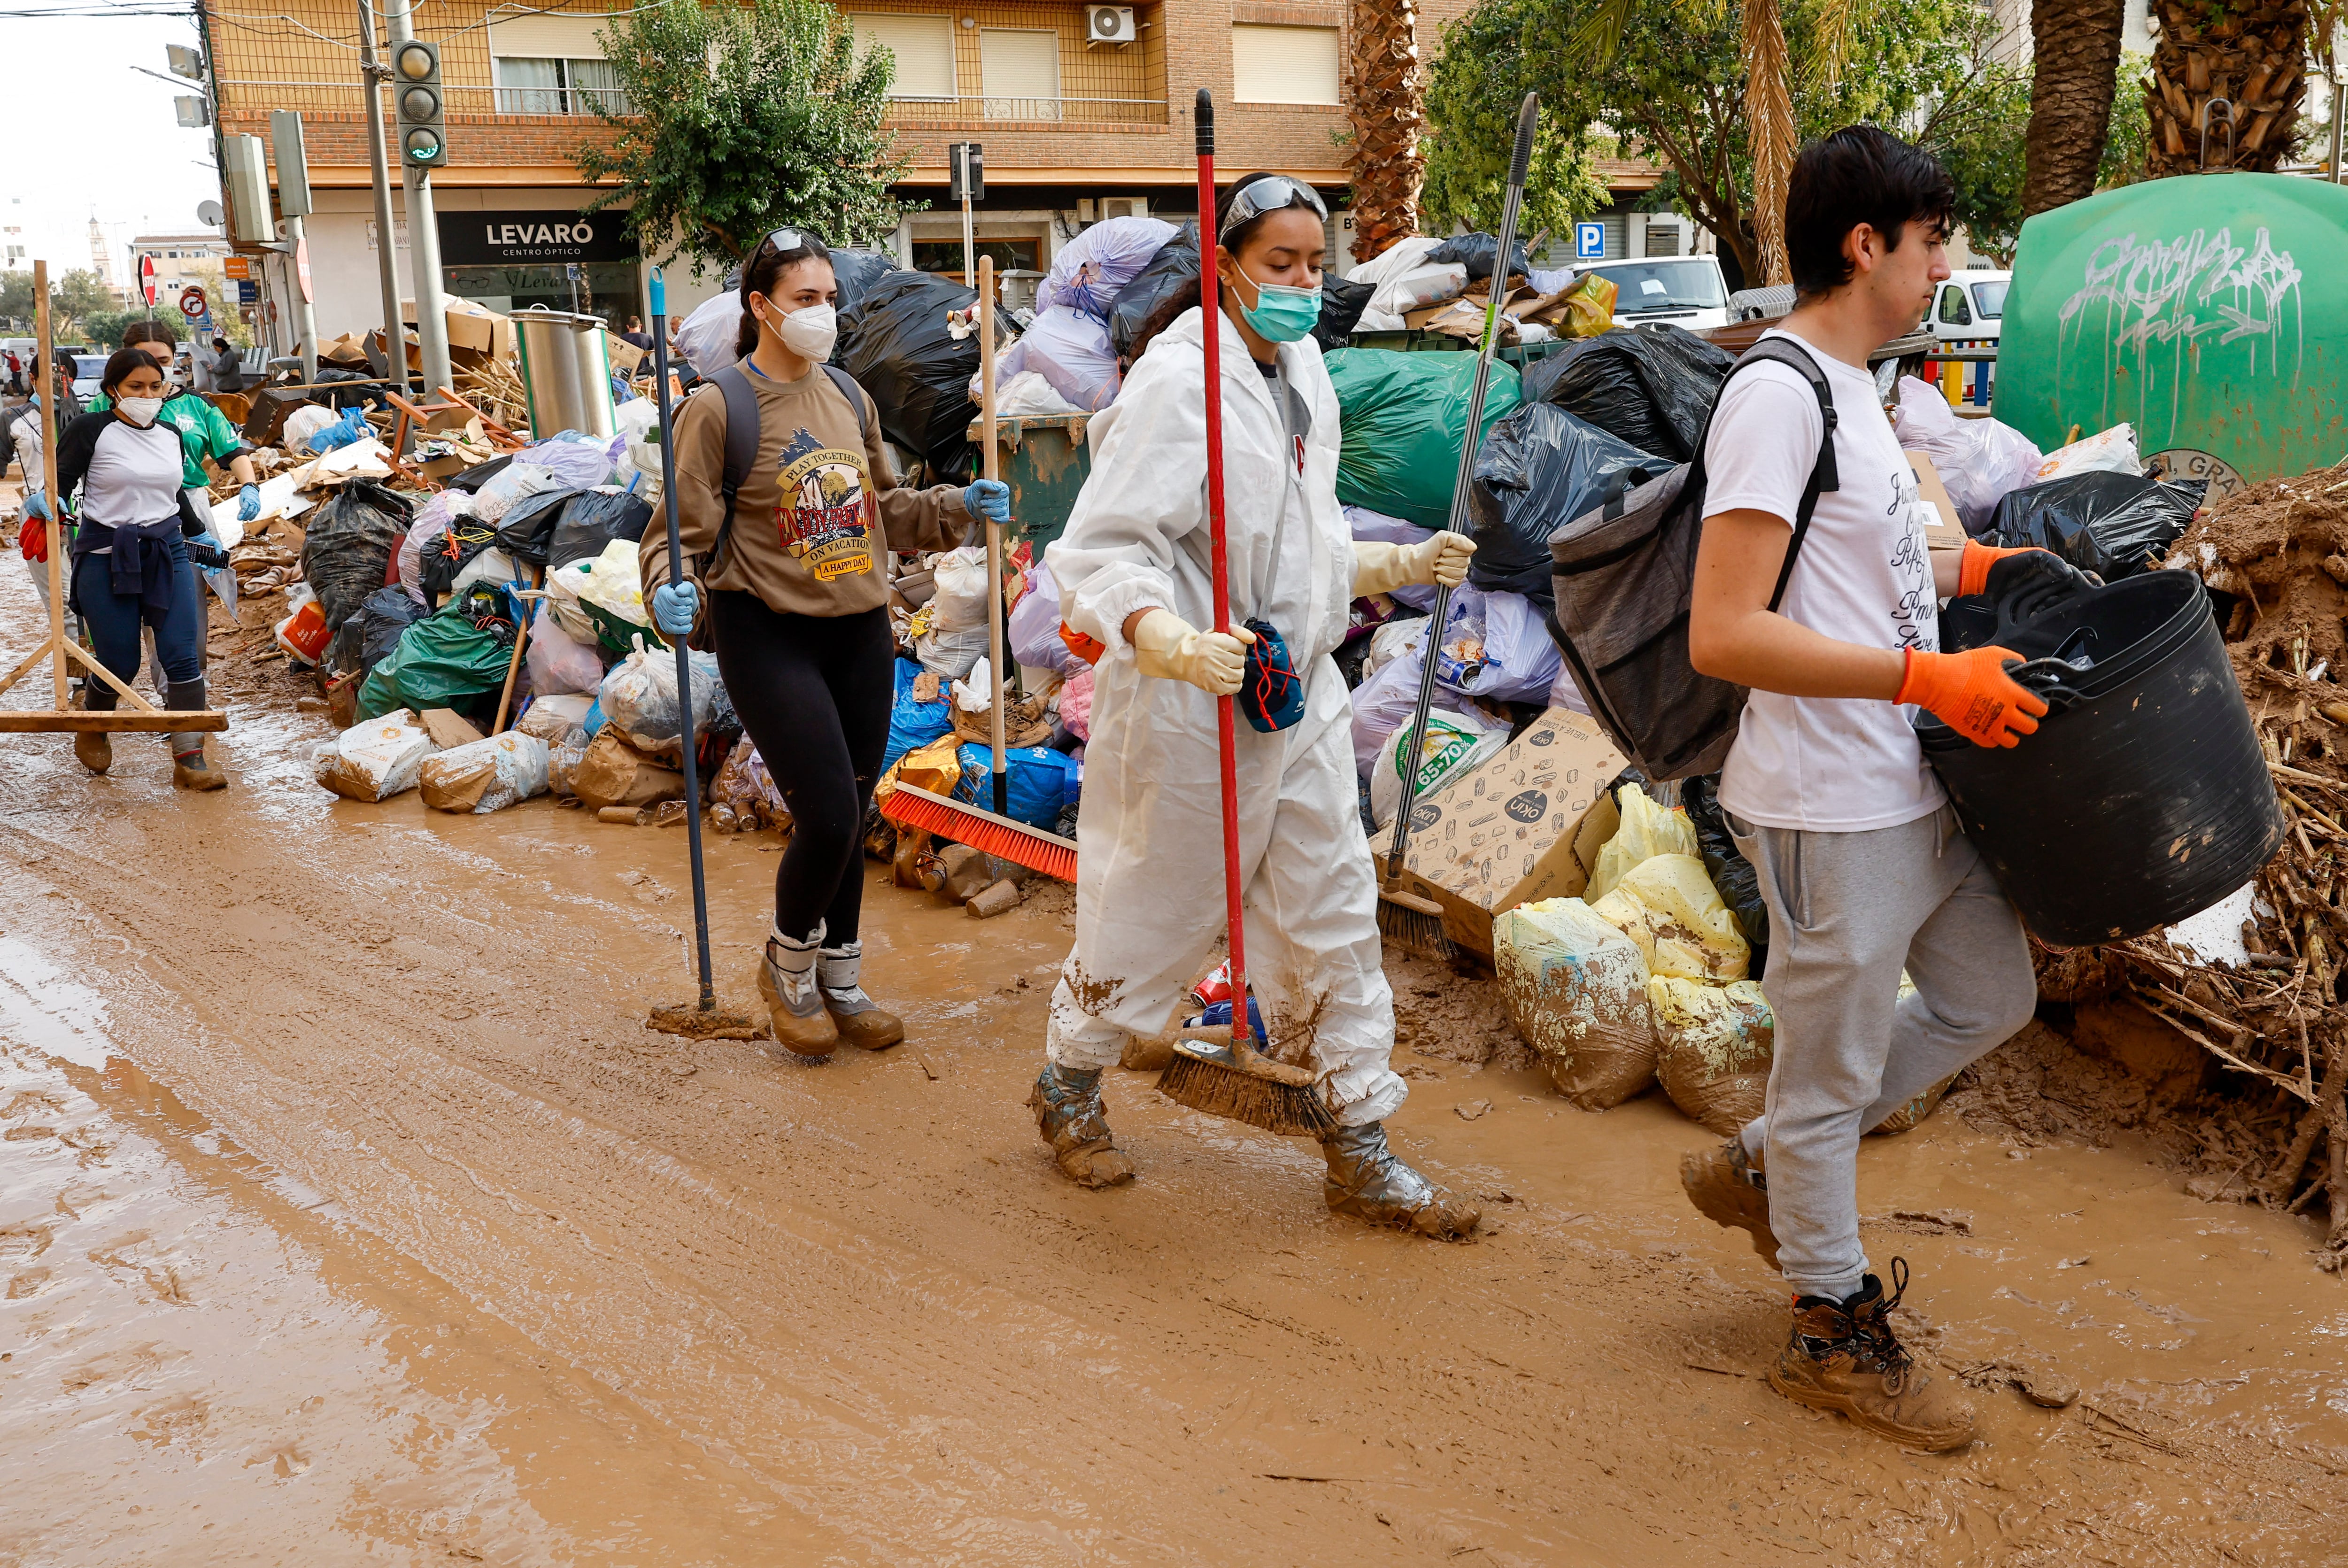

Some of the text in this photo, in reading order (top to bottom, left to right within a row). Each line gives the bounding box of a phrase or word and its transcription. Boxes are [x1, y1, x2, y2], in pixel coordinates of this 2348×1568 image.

[486, 218, 593, 245] LEVARÓ
[1582, 226, 1600, 255] P
[144, 275, 154, 288] STOP
[1482, 336, 1487, 346] cm
[786, 452, 863, 481] PLAY TOGETHER
[773, 507, 829, 548] ENJOY
[810, 539, 870, 562] ON VACATION
[830, 562, 853, 572] HAPPY
[853, 557, 866, 567] DAY
[309, 629, 317, 641] verde
[1537, 718, 1559, 729] COMER
[1564, 728, 1589, 742] VUELVE
